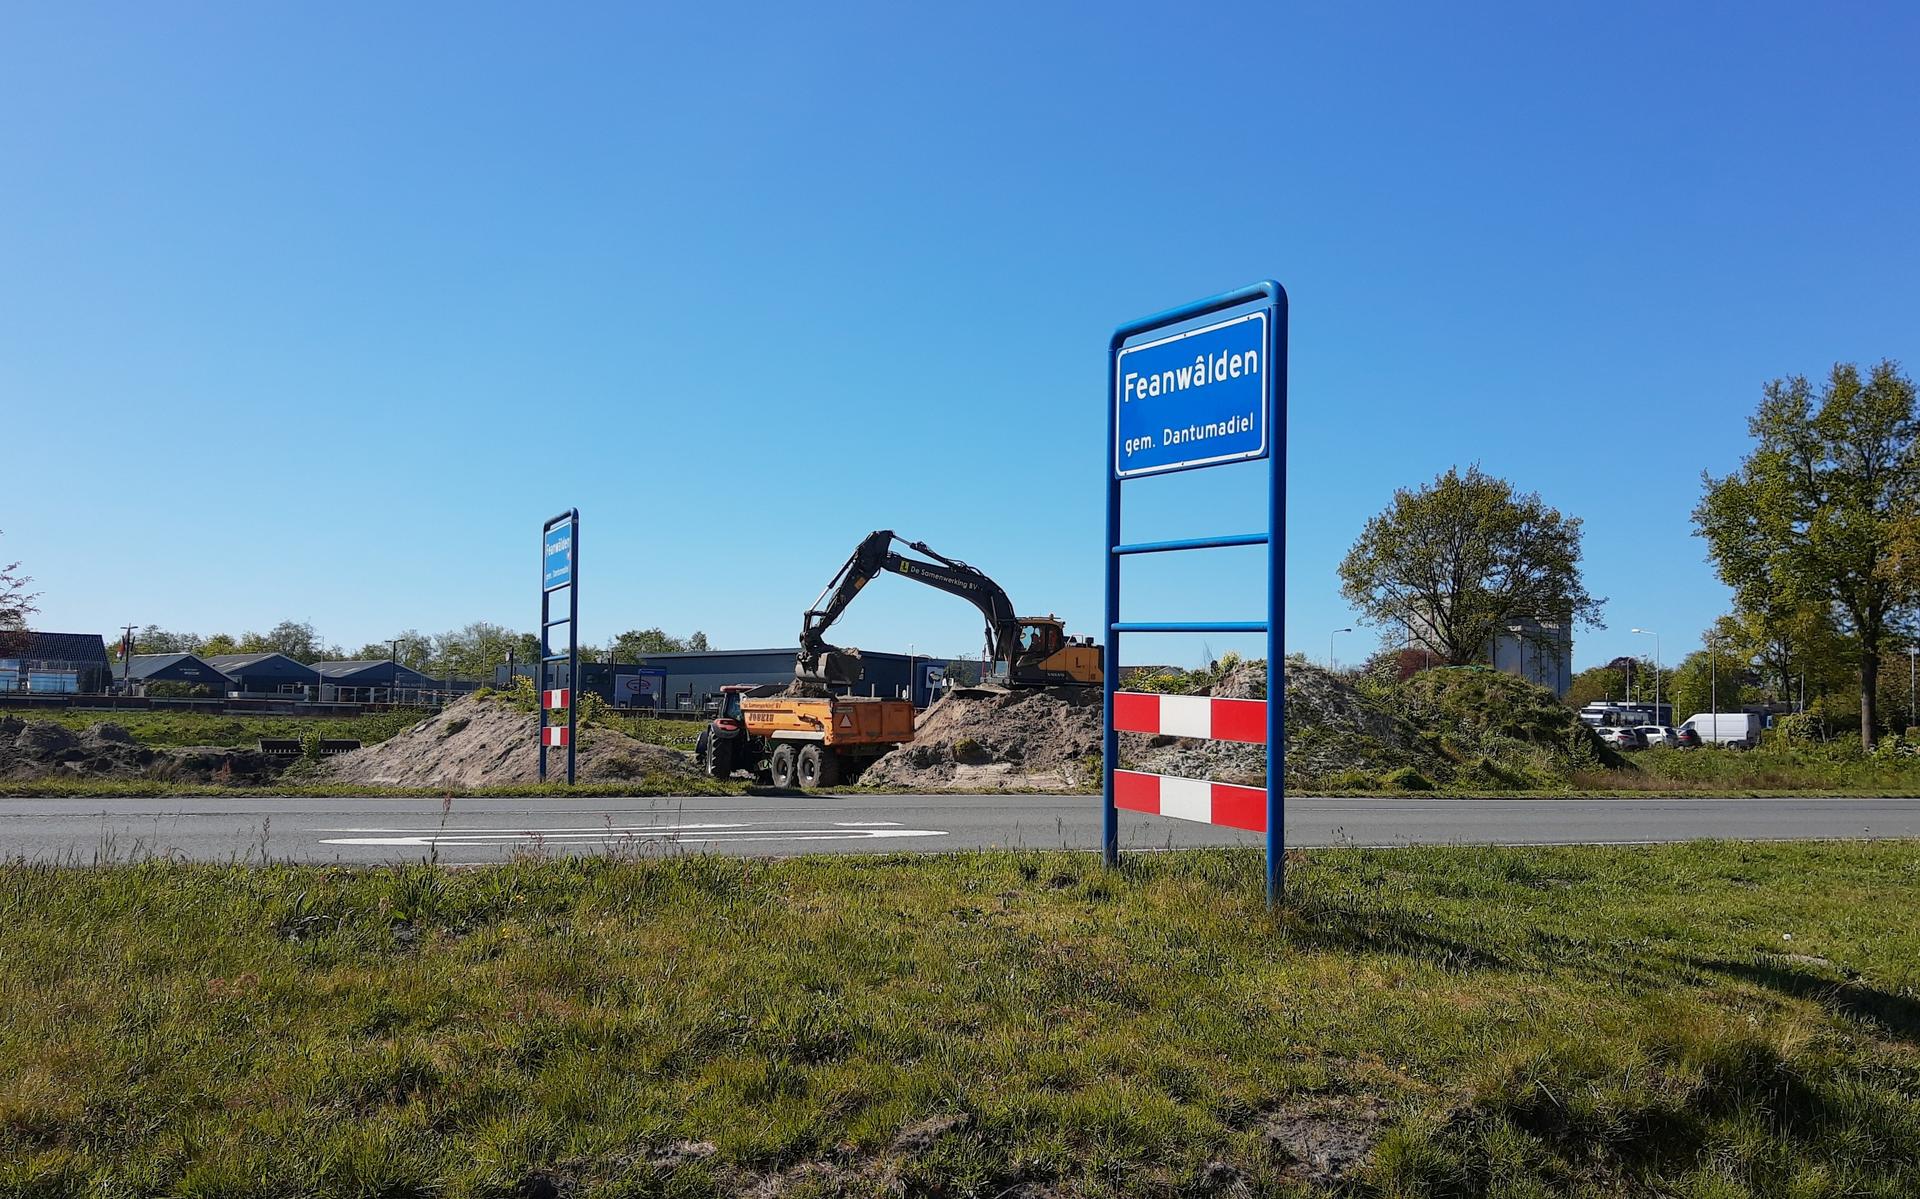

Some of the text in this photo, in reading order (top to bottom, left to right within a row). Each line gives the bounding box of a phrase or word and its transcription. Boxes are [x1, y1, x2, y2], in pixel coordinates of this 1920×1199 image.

[1124, 349, 1258, 403] Feanwâlden
[1125, 412, 1253, 457] gem. Dantumadiel
[910, 566, 920, 574] De
[921, 569, 968, 589] Samenwerking
